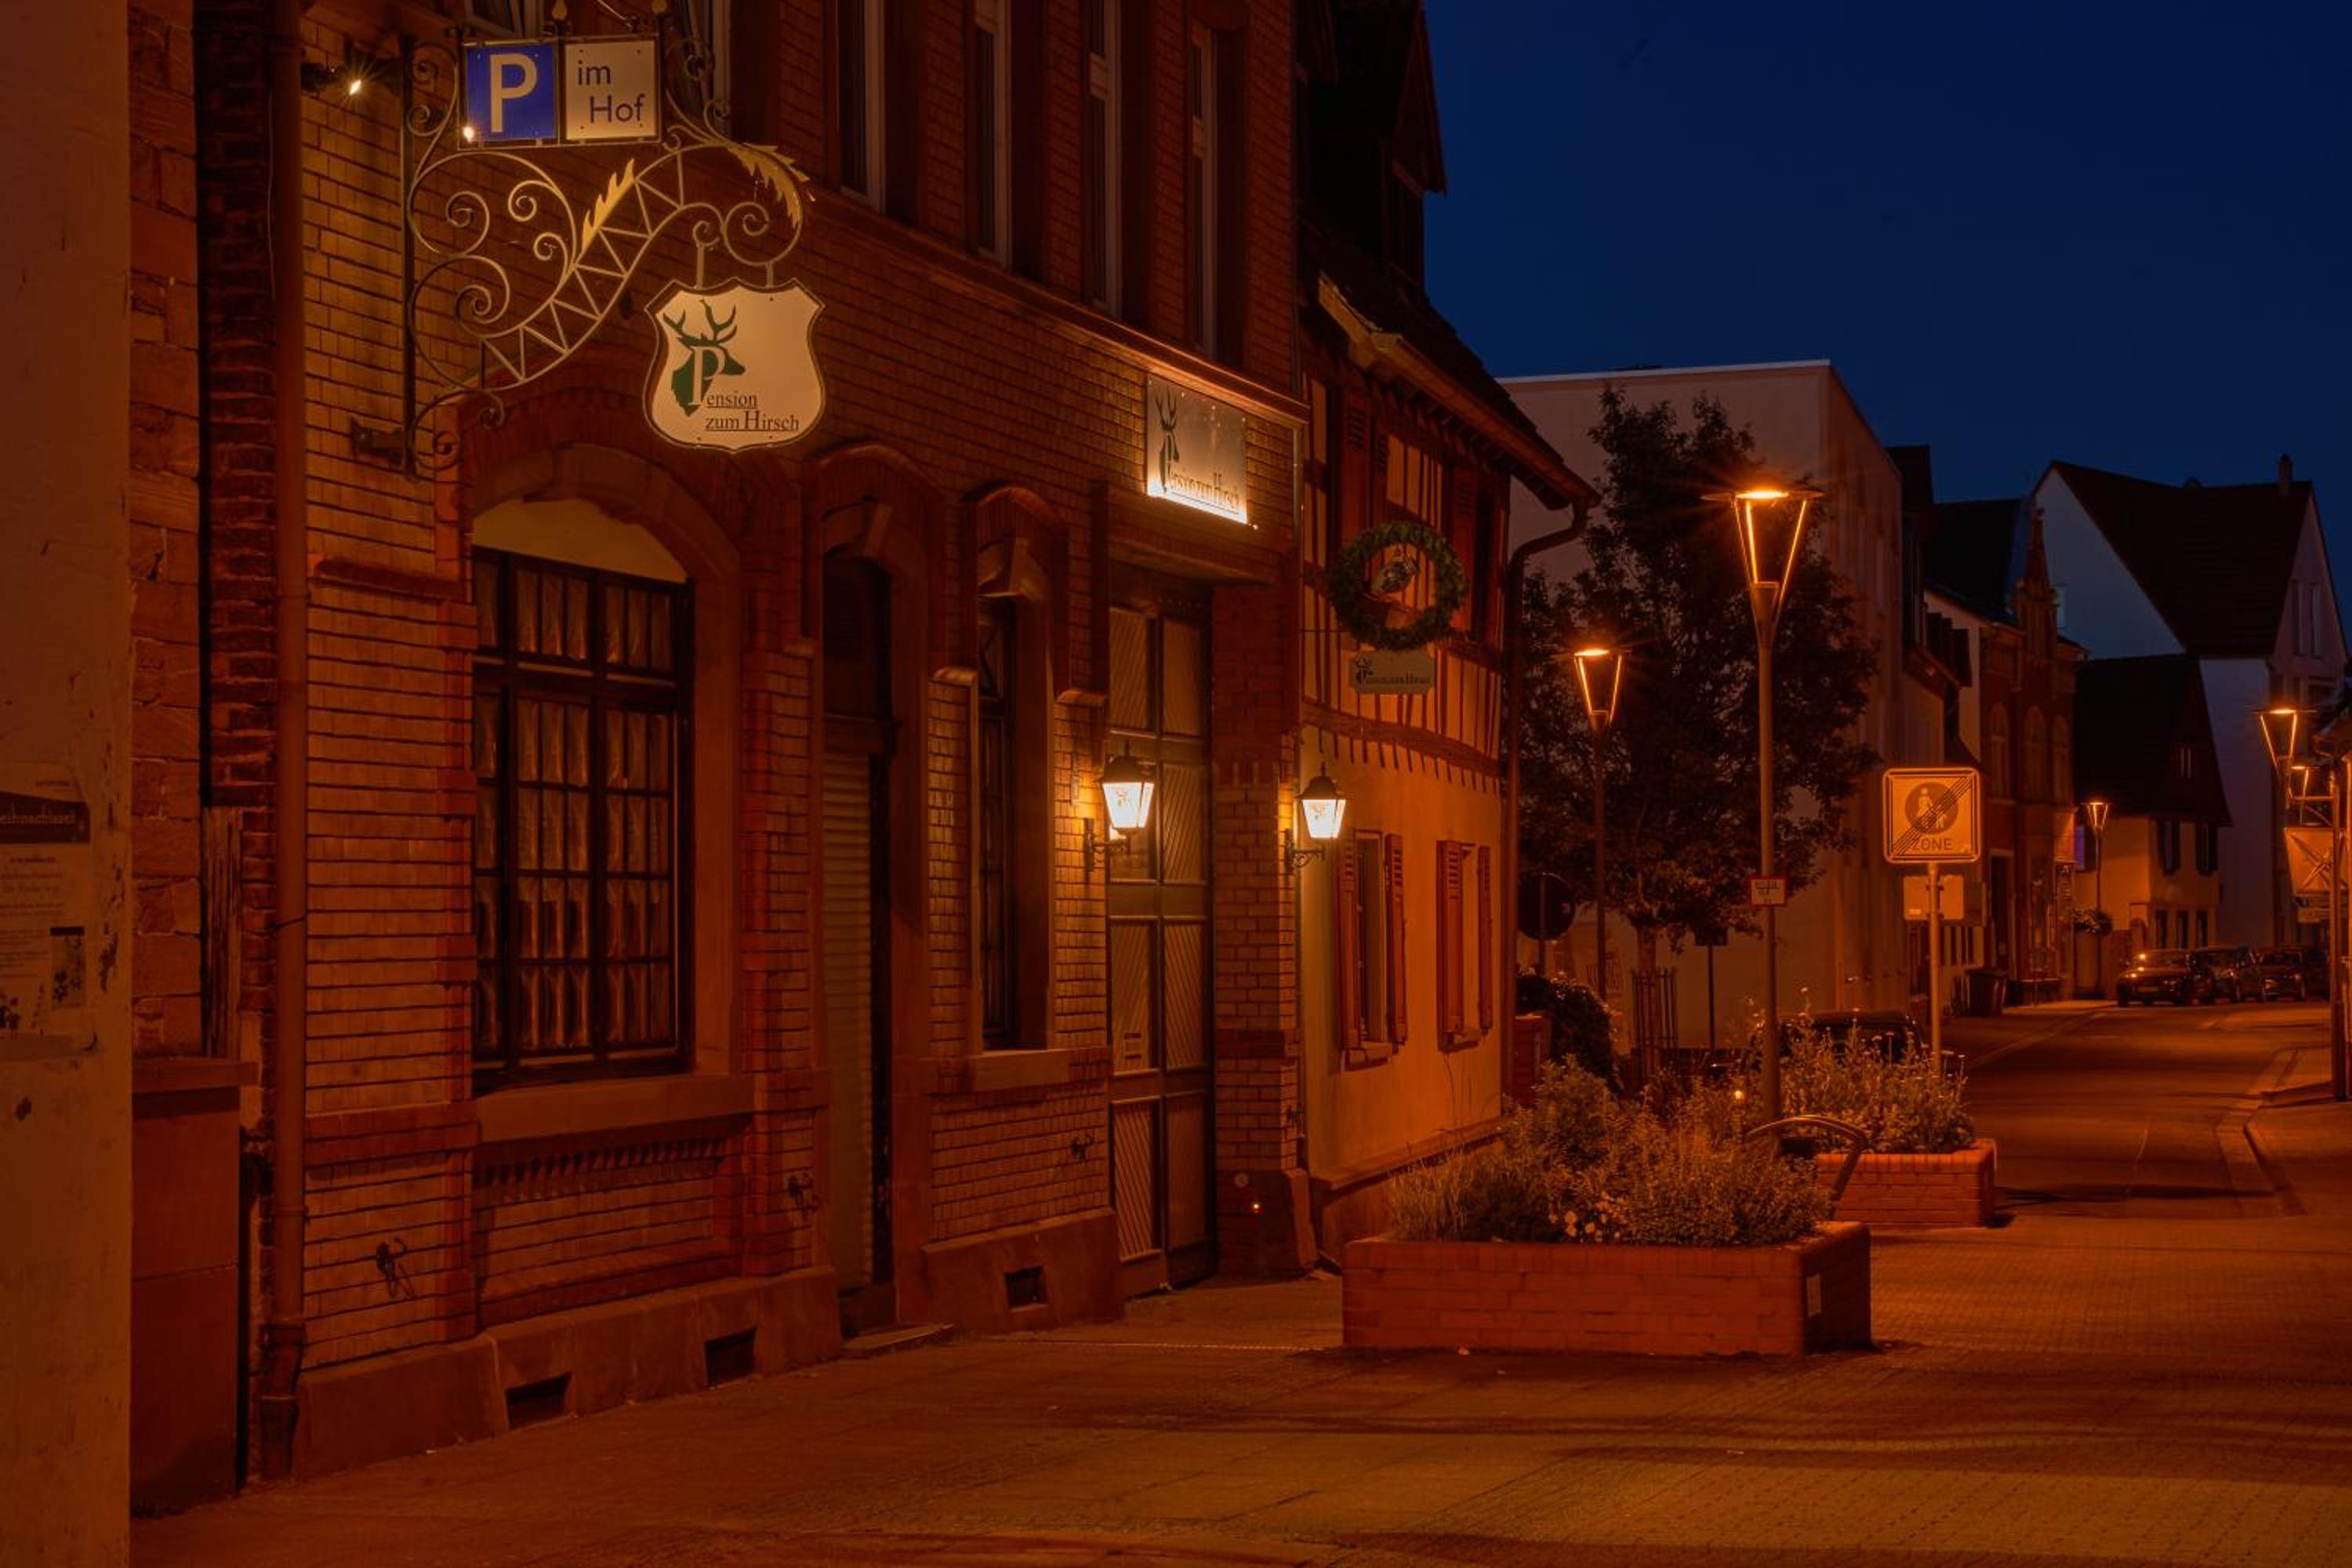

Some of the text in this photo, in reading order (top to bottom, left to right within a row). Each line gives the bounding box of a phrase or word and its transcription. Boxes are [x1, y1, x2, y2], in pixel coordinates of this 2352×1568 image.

[578, 60, 612, 85] im
[490, 53, 537, 132] P
[590, 93, 646, 123] Hof
[688, 345, 758, 406] Pension
[706, 410, 800, 431] zum Hirsch
